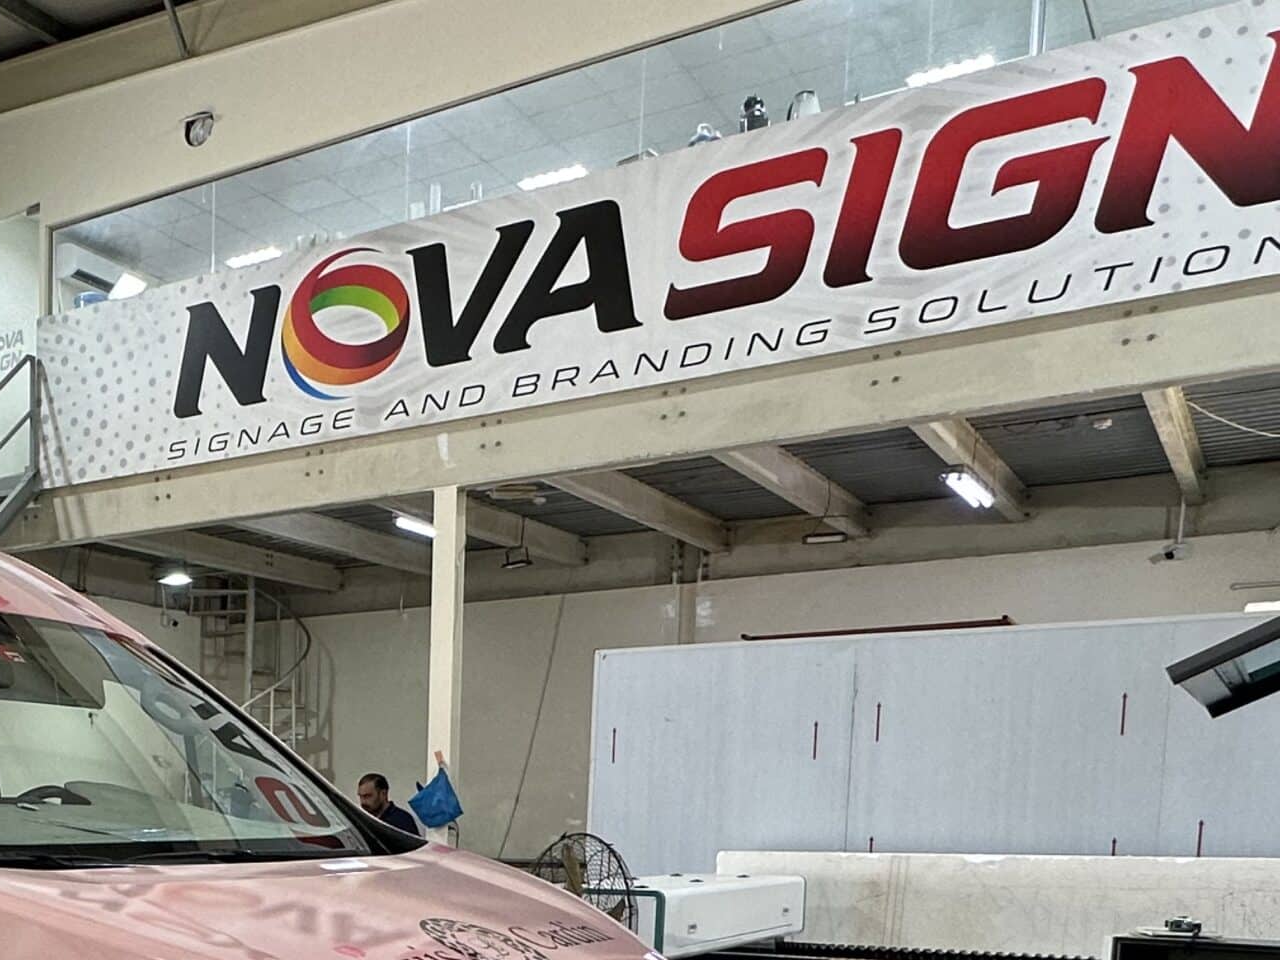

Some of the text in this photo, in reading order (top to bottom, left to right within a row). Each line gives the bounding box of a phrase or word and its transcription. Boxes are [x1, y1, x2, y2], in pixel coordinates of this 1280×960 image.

[173, 199, 644, 419] NOVA
[166, 407, 355, 461] SIGNAGE
[383, 383, 486, 422] AND
[511, 319, 832, 398] BRANDING
[508, 921, 615, 951] Cardin
